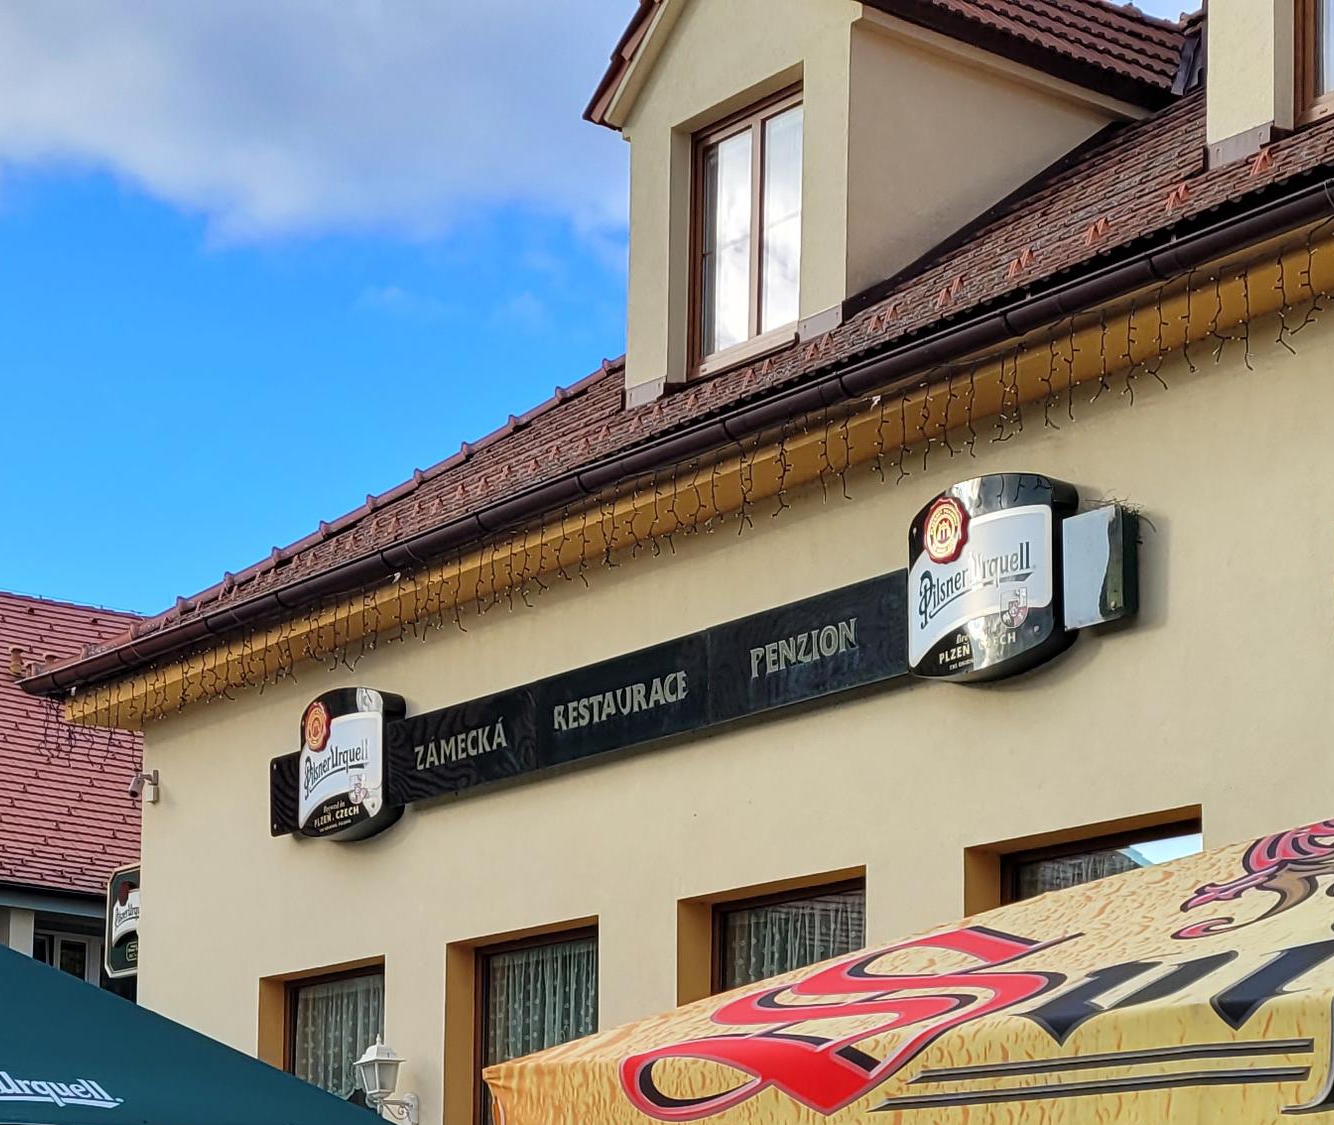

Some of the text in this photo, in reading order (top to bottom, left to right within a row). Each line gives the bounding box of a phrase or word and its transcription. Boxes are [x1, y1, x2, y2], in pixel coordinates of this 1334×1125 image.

[918, 567, 968, 631] Pilsner
[414, 617, 859, 771] ZÁMECKÁ RESTAURACE PENZION
[304, 738, 369, 801] Pilsner Urquell
[335, 805, 360, 820] CZECH
